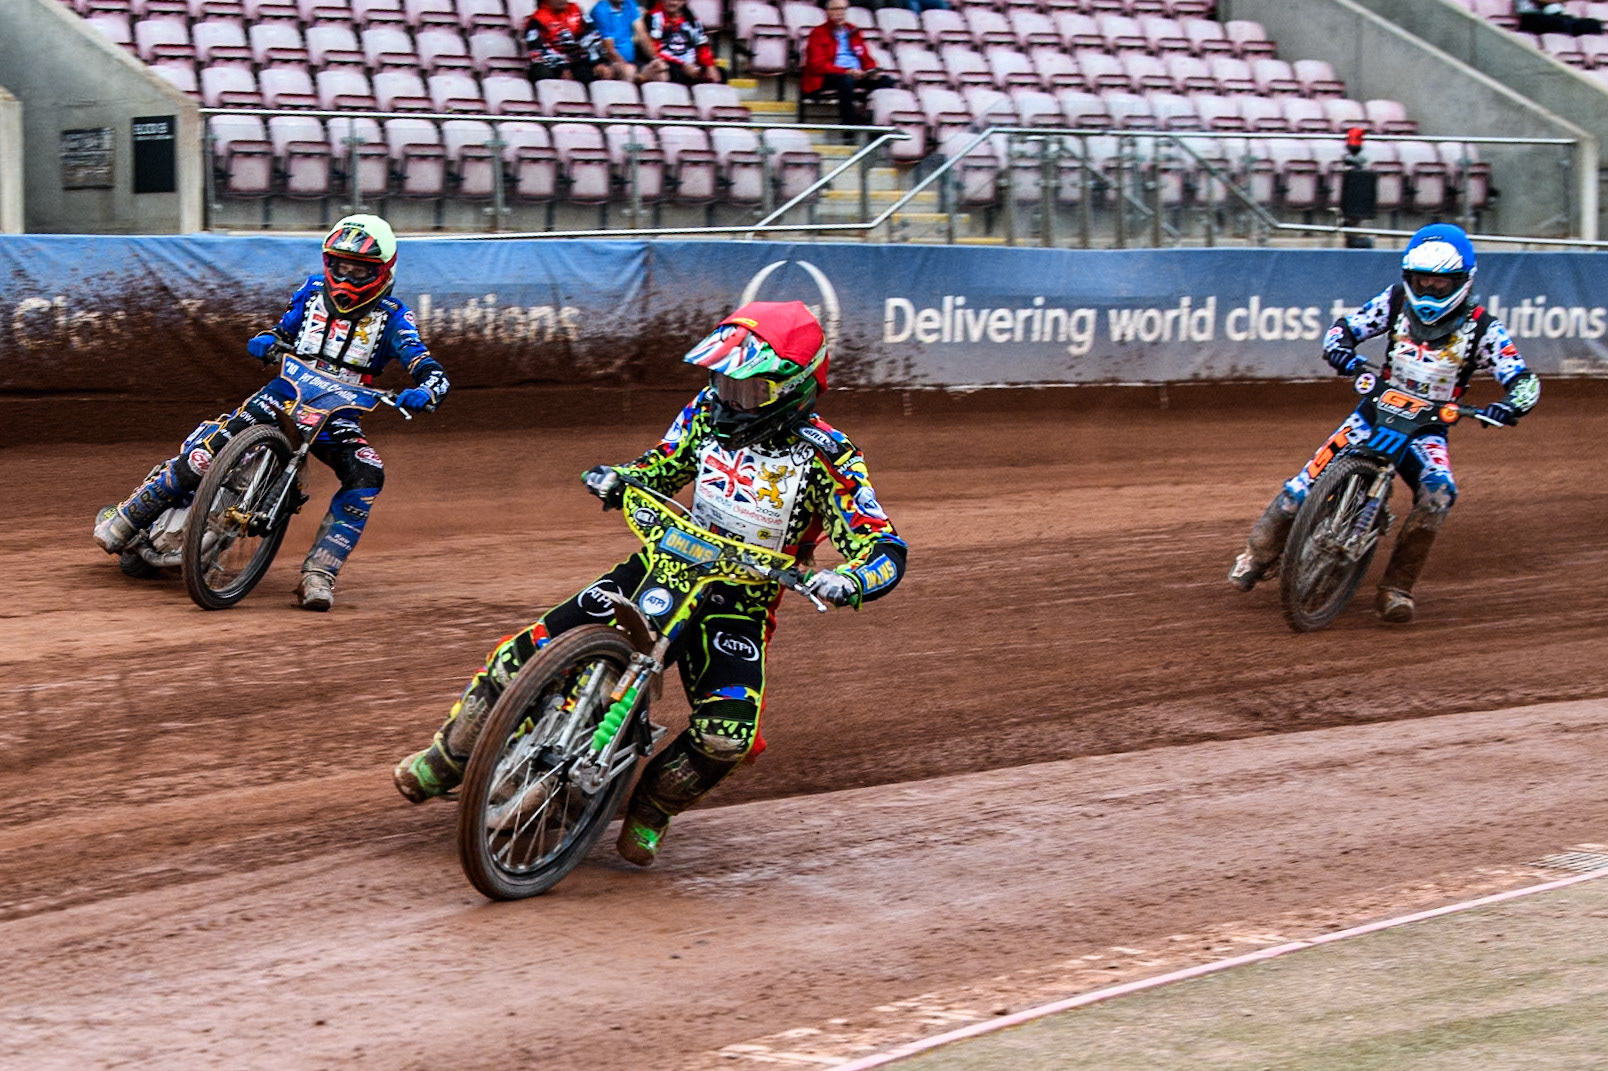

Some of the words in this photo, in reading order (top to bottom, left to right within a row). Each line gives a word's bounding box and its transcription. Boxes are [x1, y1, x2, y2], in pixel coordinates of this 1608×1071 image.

[883, 296, 1098, 356] Delivering
[1108, 296, 1217, 342] world
[1225, 295, 1322, 341] class
[1487, 294, 1607, 339] lutions
[721, 639, 753, 655] ATPI
